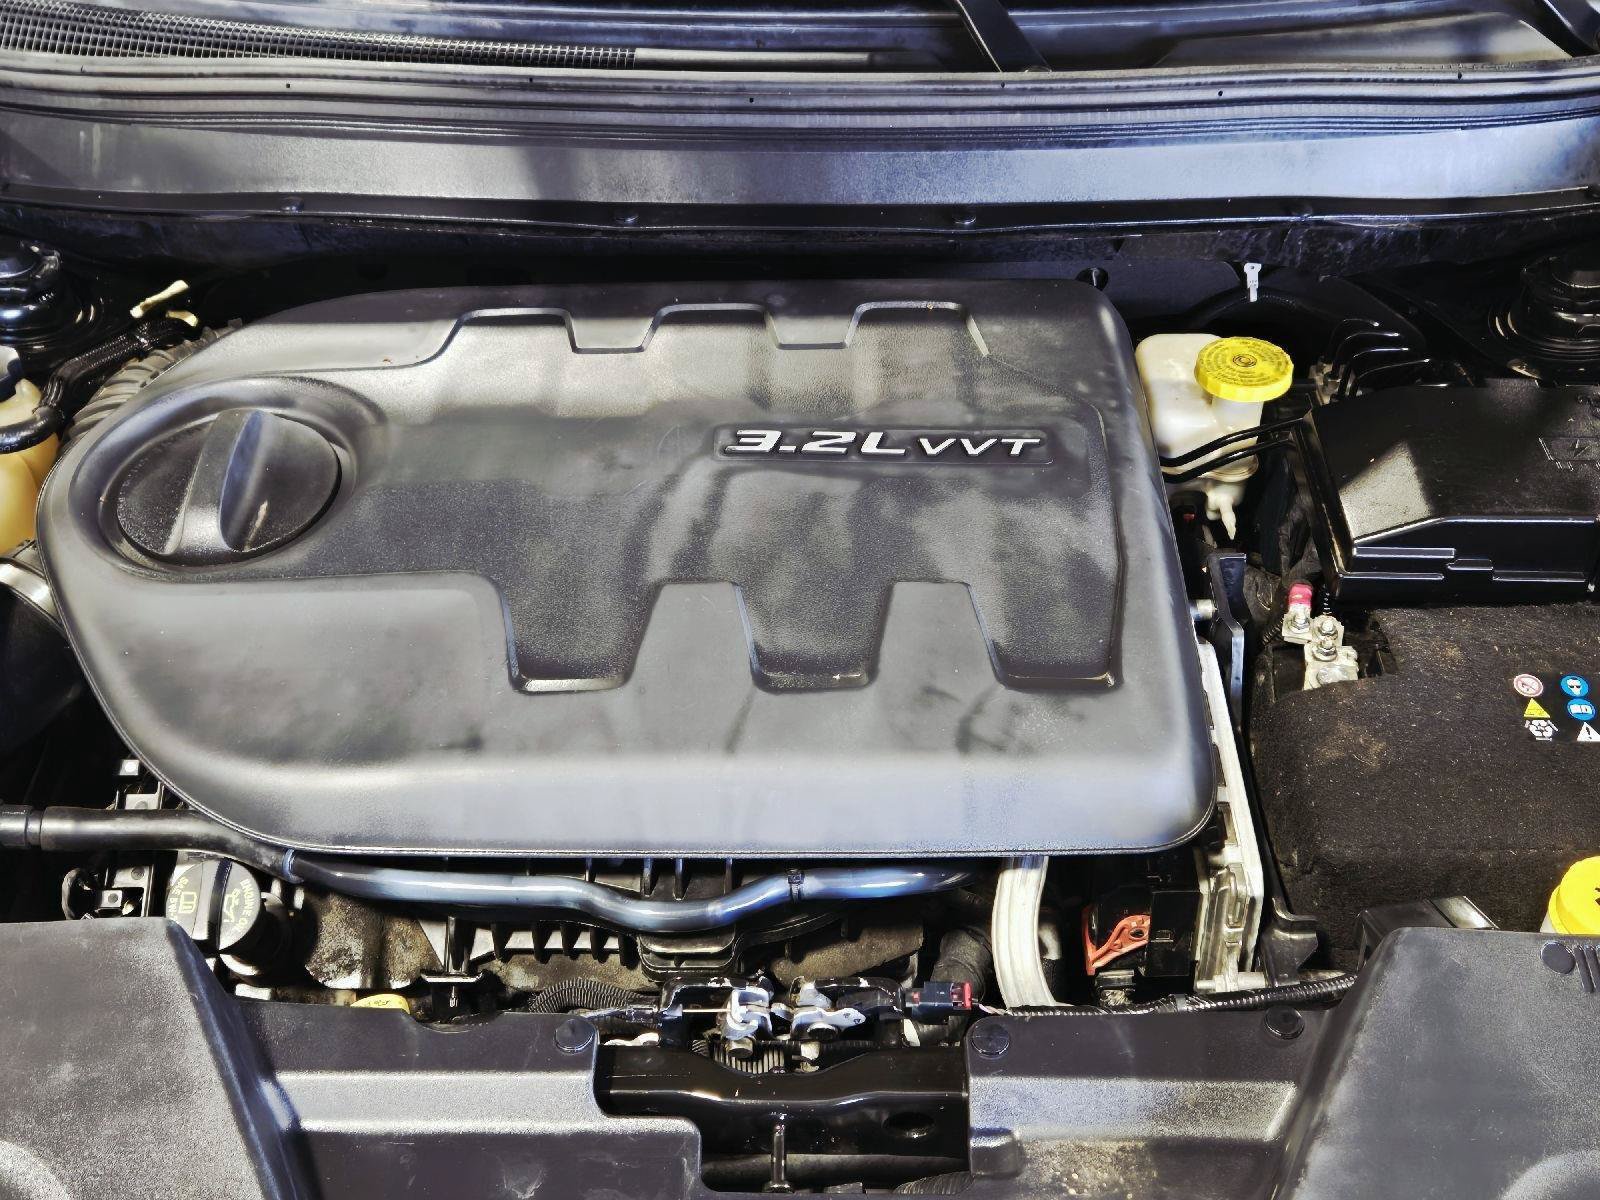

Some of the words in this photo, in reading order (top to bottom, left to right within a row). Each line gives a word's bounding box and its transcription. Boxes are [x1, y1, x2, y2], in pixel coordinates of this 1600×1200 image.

[725, 430, 906, 454] 3.2L
[918, 438, 1041, 456] VVT
[240, 878, 254, 918] ENGINE
